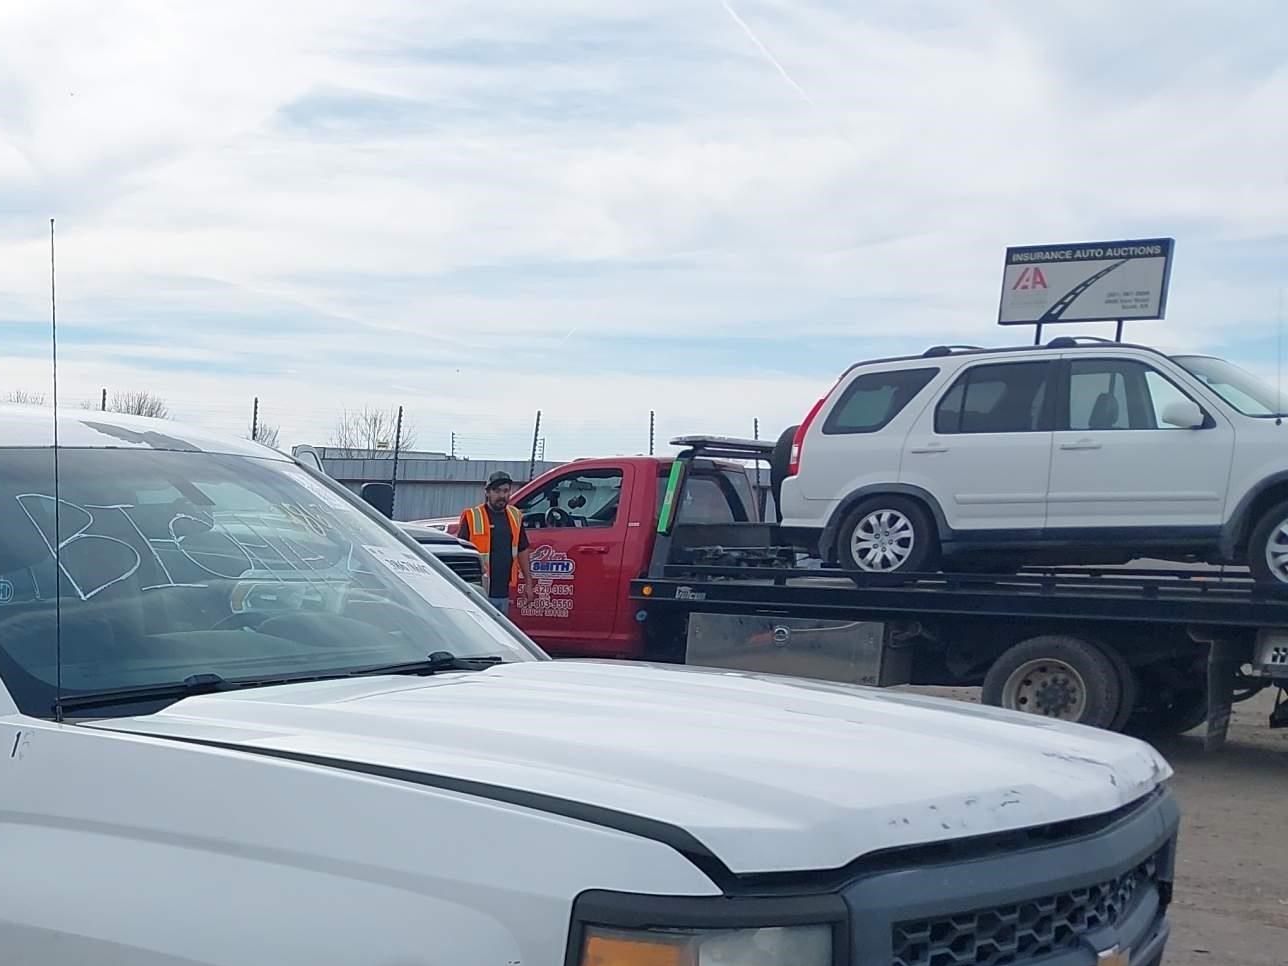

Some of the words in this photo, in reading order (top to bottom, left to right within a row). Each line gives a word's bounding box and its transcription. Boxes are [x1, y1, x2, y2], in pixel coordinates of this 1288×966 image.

[1012, 250, 1072, 262] INSURANCE
[1074, 247, 1103, 259] AUTO
[1105, 245, 1162, 257] AUCTIONS
[533, 562, 569, 571] SMITH
